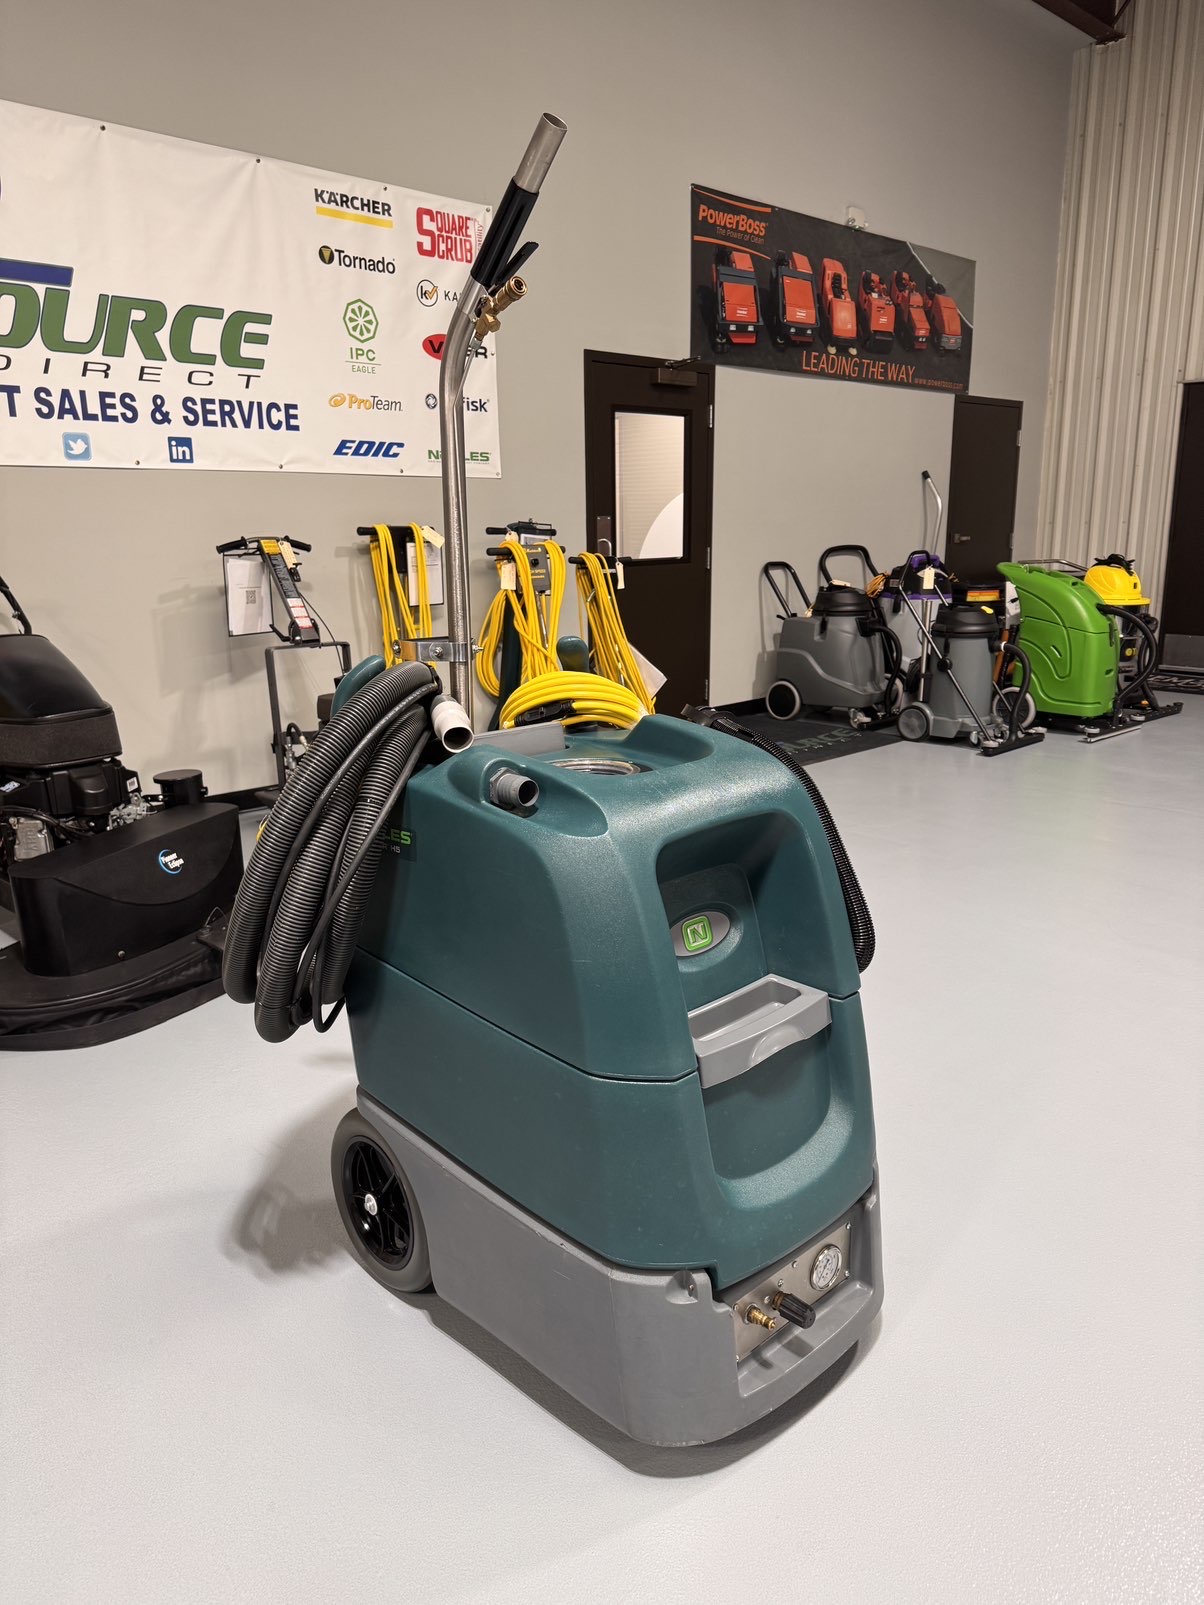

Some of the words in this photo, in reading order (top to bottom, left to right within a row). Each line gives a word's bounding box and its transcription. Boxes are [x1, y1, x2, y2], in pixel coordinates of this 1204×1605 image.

[314, 188, 393, 217] KÄRCHER
[416, 207, 473, 246] SQUARE
[698, 204, 766, 236] PowerBoss
[716, 226, 726, 236] The
[727, 228, 744, 240] Power
[744, 234, 751, 242] of
[750, 235, 765, 245] Clean
[334, 248, 396, 275] Tornado
[349, 347, 376, 362] IPC
[801, 350, 860, 378] LEADING
[861, 358, 886, 381] THE
[887, 364, 916, 384] WAY
[351, 364, 377, 375] EAGLE
[33, 387, 139, 424] SALES
[150, 394, 172, 425] &
[182, 396, 301, 431] SERVICE
[348, 393, 402, 412] ProTeam
[333, 439, 405, 458] EDIC
